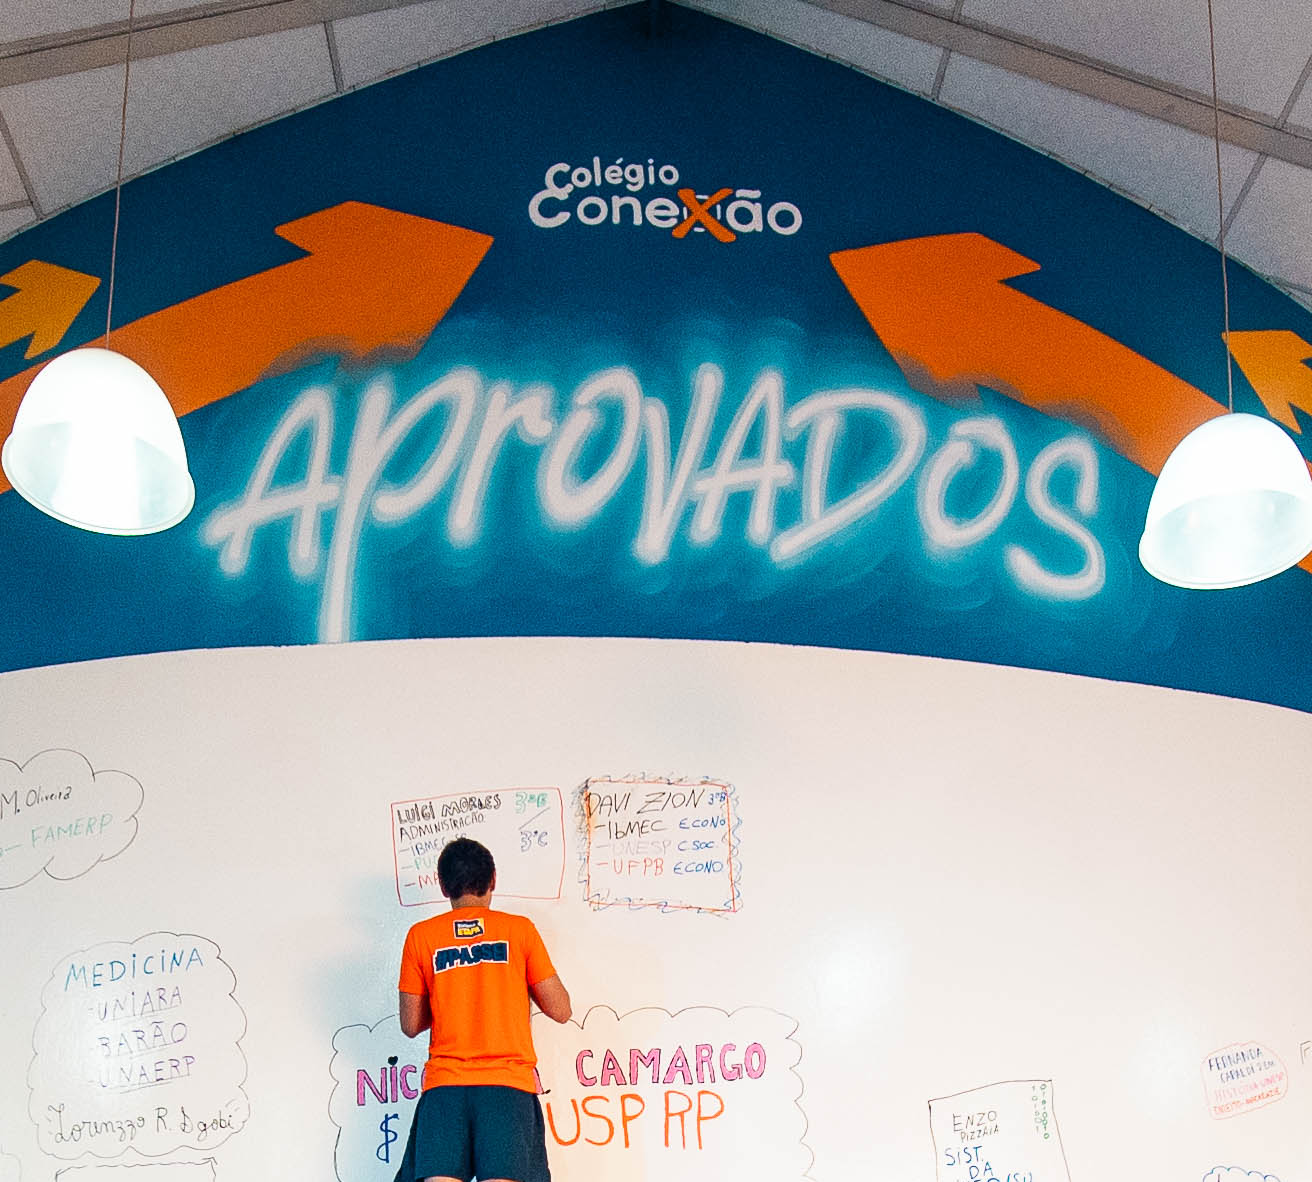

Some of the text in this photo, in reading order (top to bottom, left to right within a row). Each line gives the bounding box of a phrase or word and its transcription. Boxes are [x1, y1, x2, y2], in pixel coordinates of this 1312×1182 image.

[545, 156, 679, 193] Colégio
[588, 789, 705, 818] DAVI ZION
[31, 813, 114, 848] FAMERP
[576, 1042, 767, 1087] CAMARGO
[546, 1090, 725, 1151] USP RP
[952, 1110, 998, 1133] ENZO
[969, 1160, 994, 1180] DA
